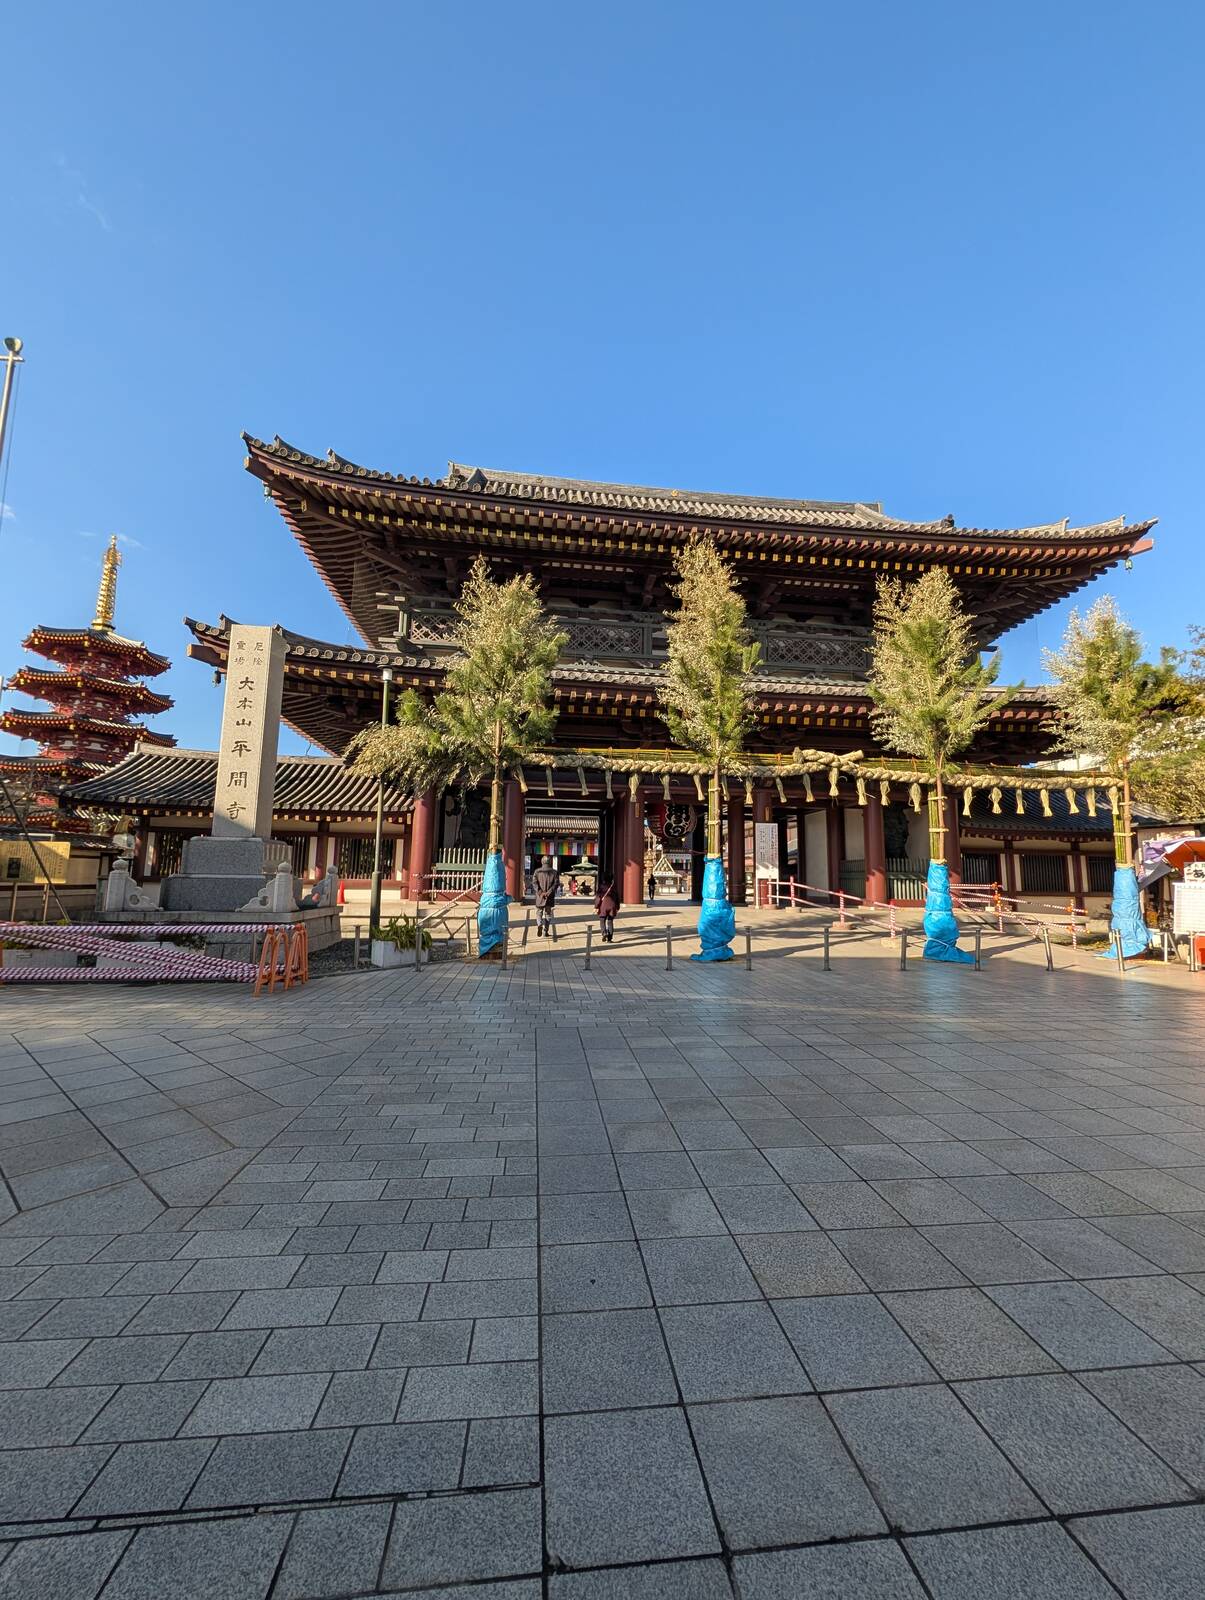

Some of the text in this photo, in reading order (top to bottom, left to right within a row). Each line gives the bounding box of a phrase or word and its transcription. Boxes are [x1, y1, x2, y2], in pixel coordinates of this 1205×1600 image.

[227, 677, 255, 820] 大本山平間寺
